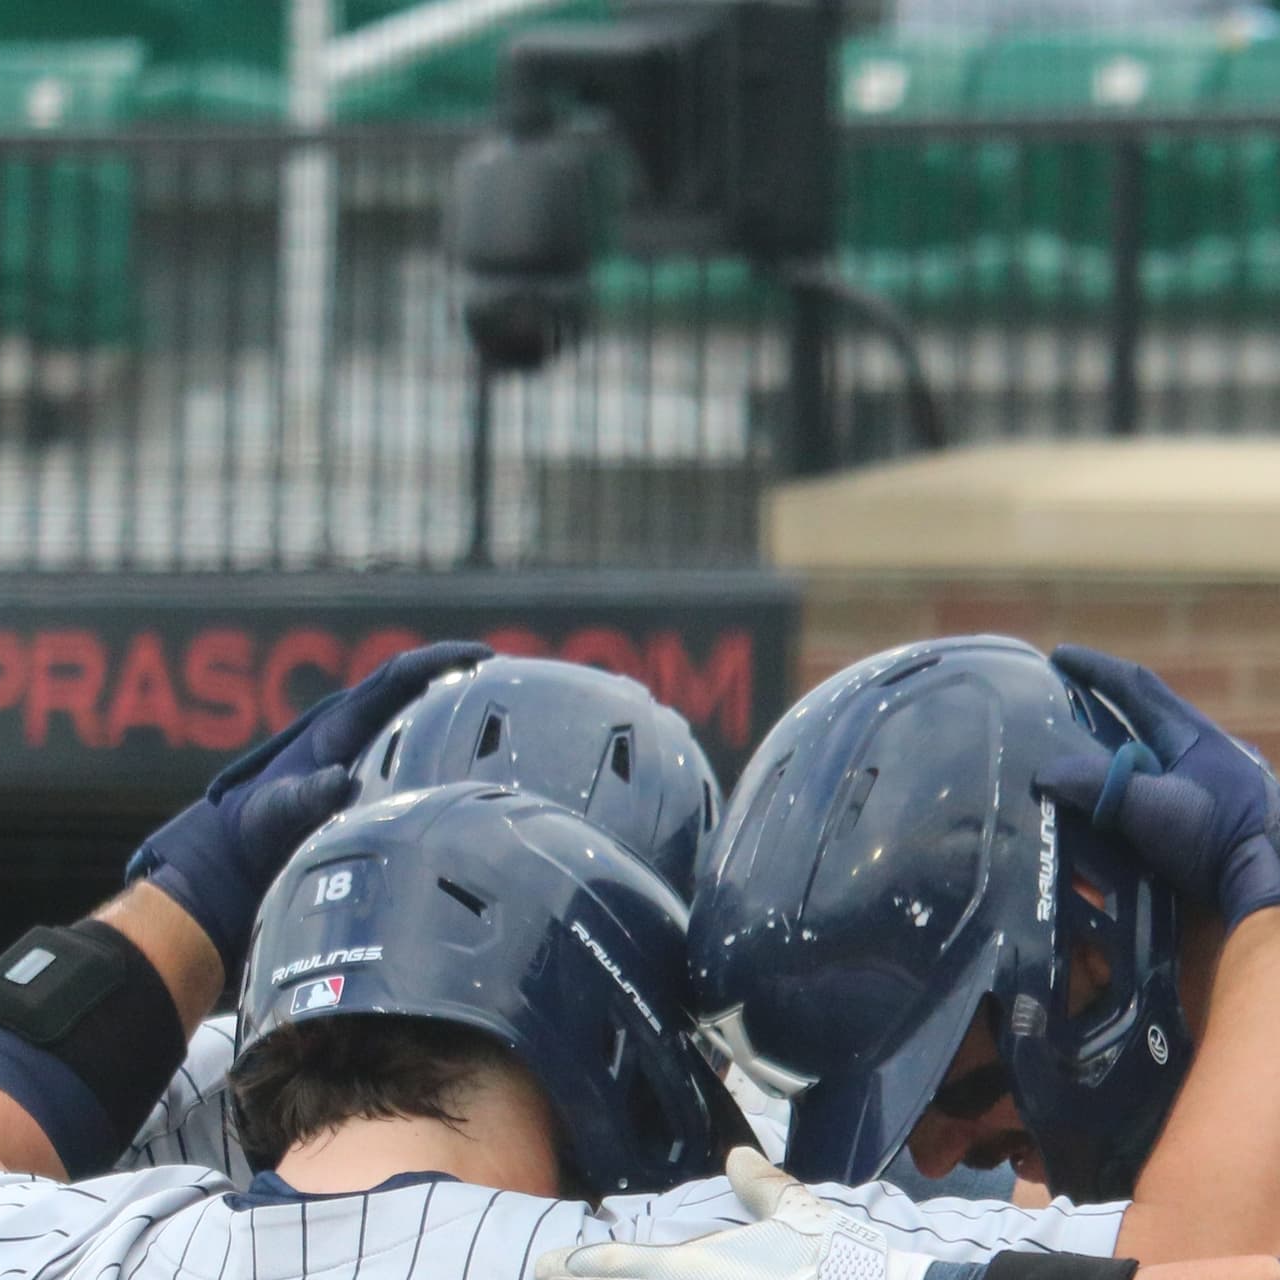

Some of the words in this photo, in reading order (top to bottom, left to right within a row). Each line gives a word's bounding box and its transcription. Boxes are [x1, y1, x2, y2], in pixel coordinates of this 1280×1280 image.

[313, 871, 353, 906] 18
[1036, 795, 1056, 923] RAWLING
[271, 946, 384, 985] RAWLINGS
[570, 920, 663, 1035] RAWLINGS
